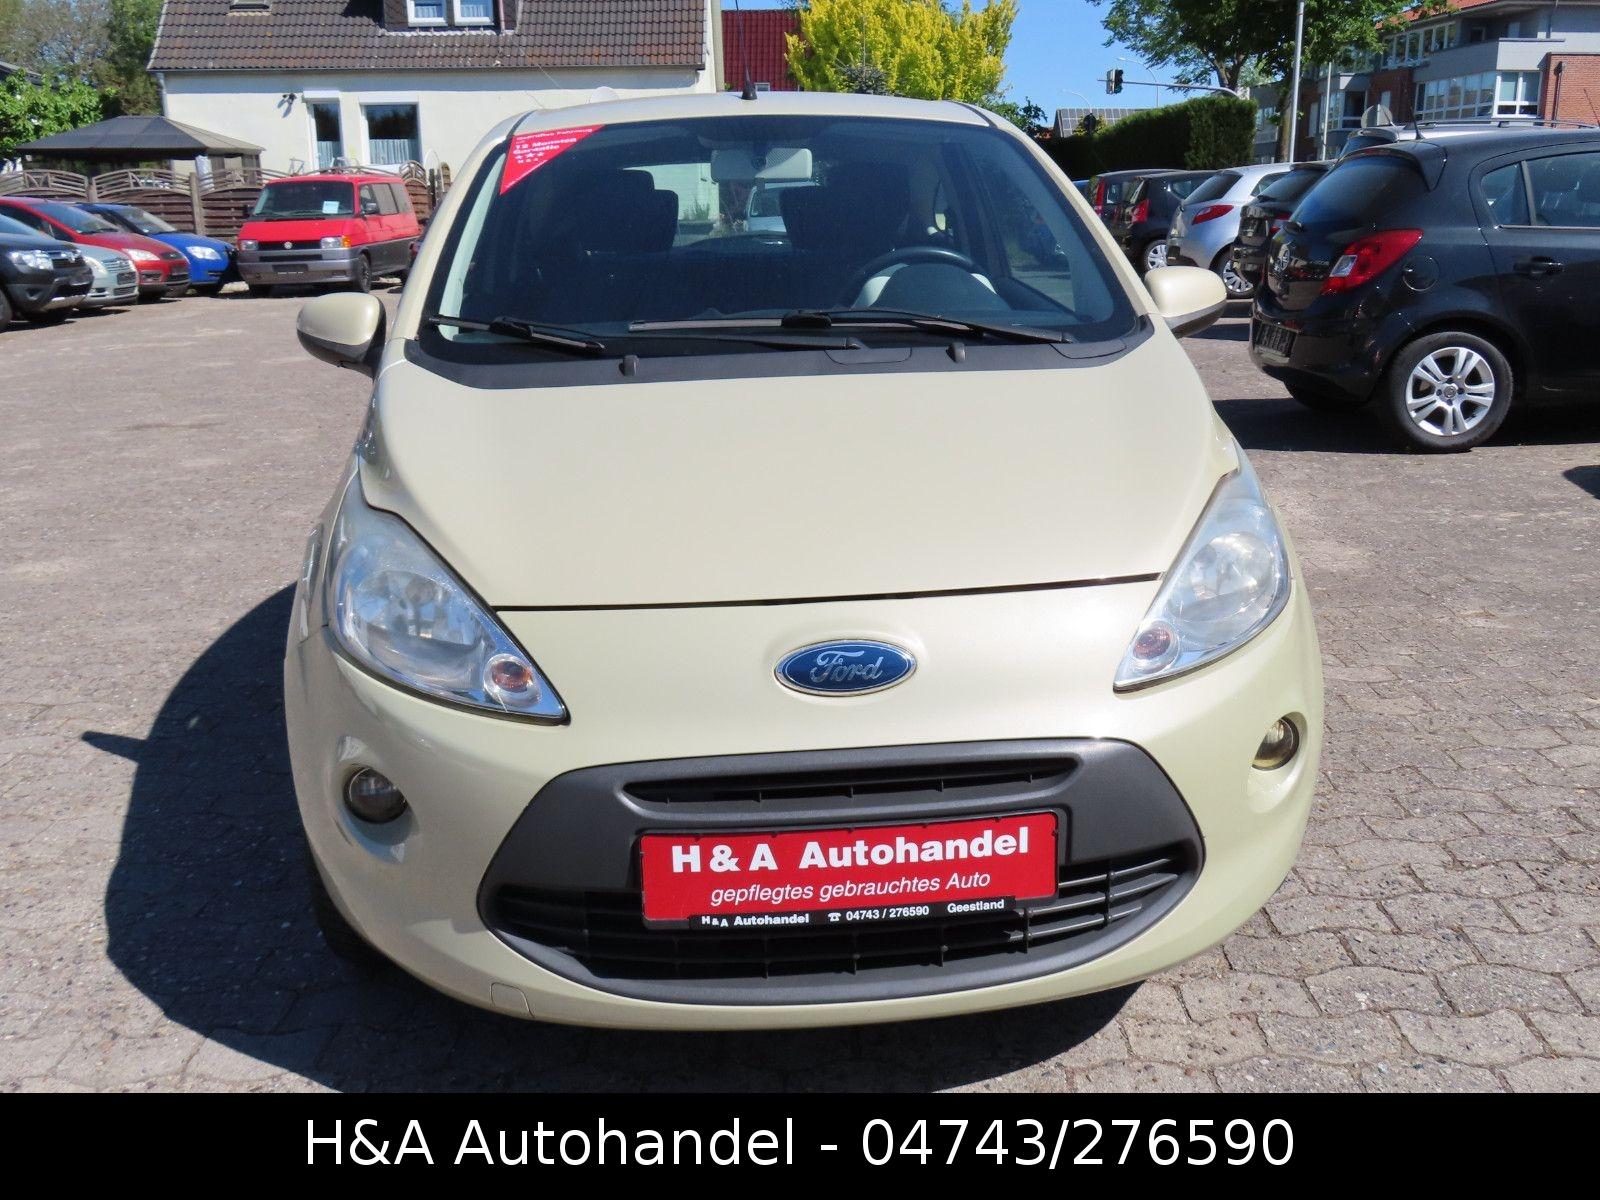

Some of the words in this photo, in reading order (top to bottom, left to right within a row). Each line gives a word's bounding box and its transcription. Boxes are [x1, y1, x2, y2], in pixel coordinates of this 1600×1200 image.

[513, 145, 560, 155] Garantie
[809, 650, 884, 683] Ford
[799, 827, 1029, 868] Autohandel
[710, 884, 813, 907] gepflegtes
[819, 876, 940, 903] gebrauchtes
[945, 872, 991, 890] Auto
[734, 913, 810, 926] Autohandel
[947, 899, 1005, 914] Geestland
